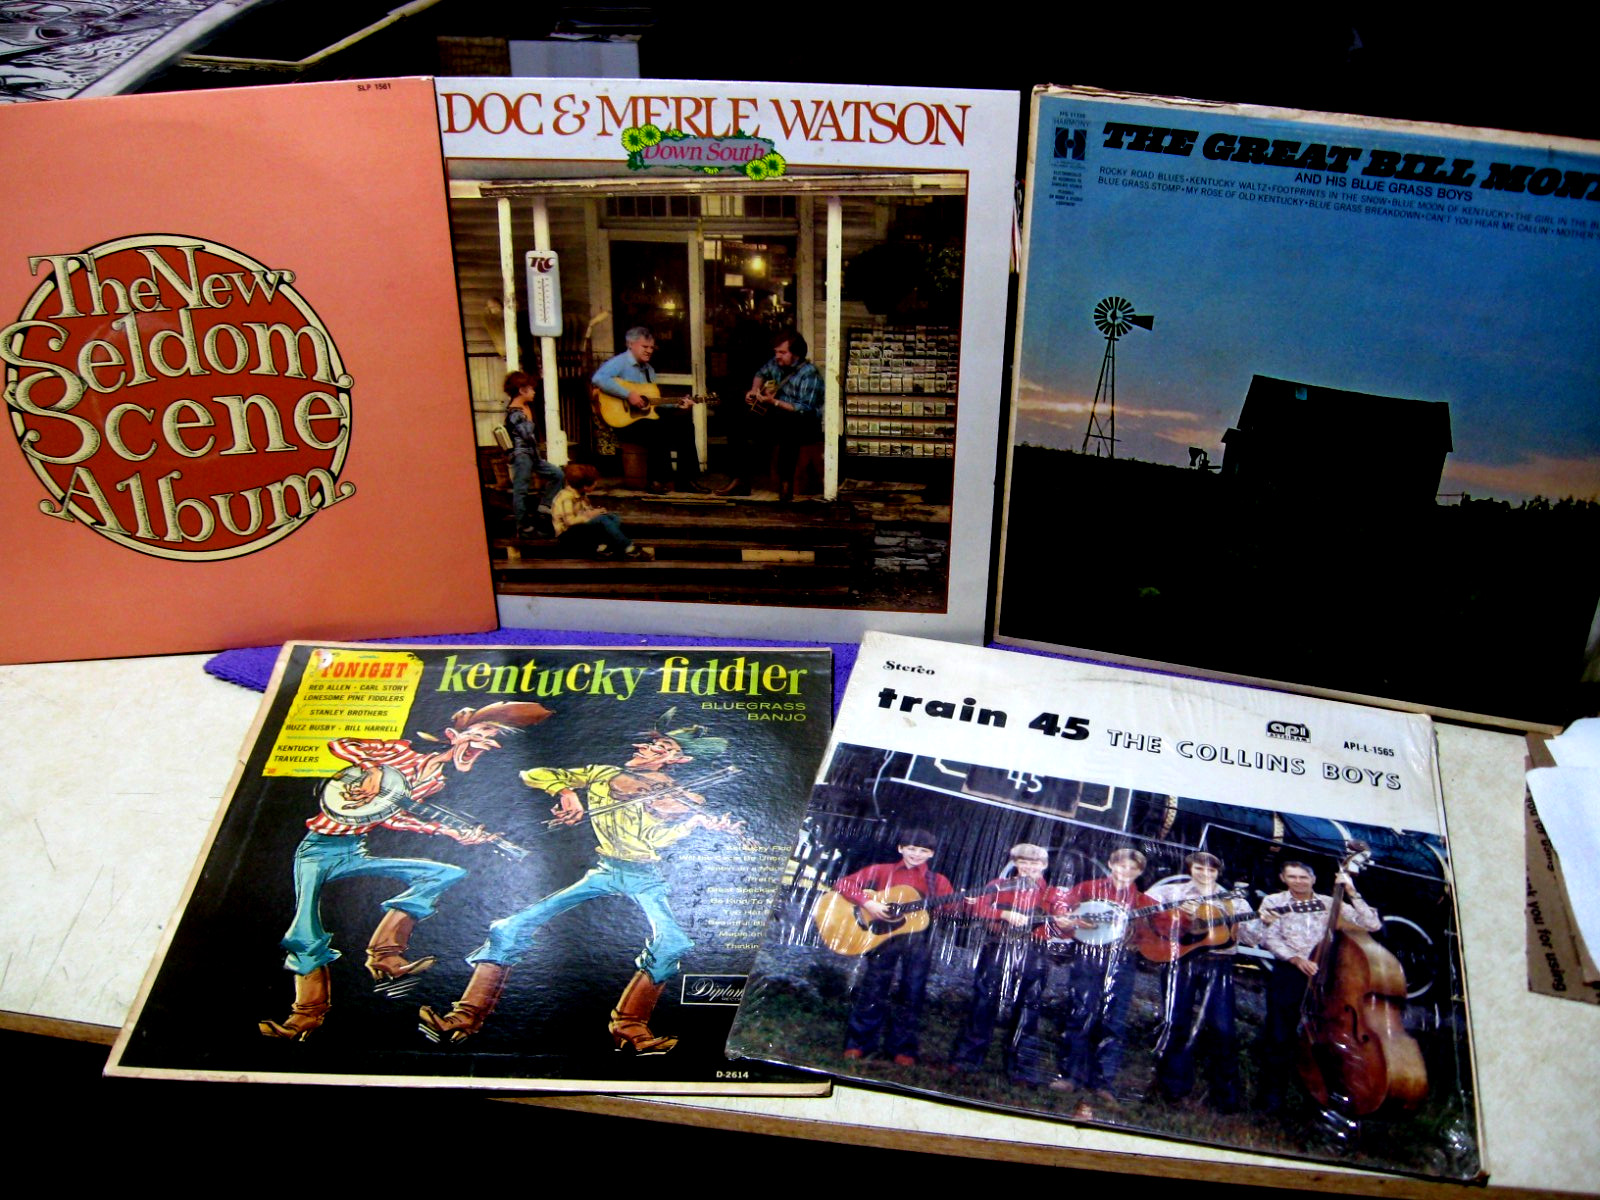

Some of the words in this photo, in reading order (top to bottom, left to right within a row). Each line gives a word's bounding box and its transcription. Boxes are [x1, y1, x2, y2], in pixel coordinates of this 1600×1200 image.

[357, 83, 371, 91] SLP
[440, 92, 544, 135] DOC
[552, 93, 590, 136] &
[596, 95, 760, 138] MERLE
[770, 98, 972, 147] WATSON
[643, 142, 703, 160] Down
[706, 142, 766, 162] South
[1103, 121, 1199, 157] THE
[1202, 132, 1363, 174] GREAT
[1361, 149, 1477, 187] BILL
[1097, 175, 1121, 186] BLUE
[1121, 177, 1150, 190] GRASS
[1152, 181, 1181, 192] STOMP
[1185, 185, 1198, 195] MY
[1201, 187, 1222, 198] ROSE
[1224, 189, 1236, 199] OF
[1238, 191, 1256, 201] OLD
[1258, 193, 1305, 207] KENTUCKY
[1308, 200, 1331, 211] BLUE
[1333, 202, 1362, 214] GRASS
[1099, 166, 1128, 176] ROCKY
[1131, 169, 1154, 180] ROAD
[1157, 172, 1184, 183] BLUES
[1187, 175, 1235, 188] KENTUCKY
[1239, 181, 1268, 192] WALTZ
[1272, 184, 1326, 199] FOOTPRINTS
[1328, 190, 1338, 200] IN
[1341, 192, 1358, 202] THE
[1361, 194, 1386, 205] SNOW
[1294, 172, 1322, 185] AND
[1325, 175, 1347, 188] HIS
[1351, 178, 1385, 192] BLUE
[1388, 182, 1433, 197] GRASS
[1437, 188, 1473, 202] BOYS
[28, 252, 162, 319] The
[136, 244, 296, 313] New
[0, 308, 355, 411] Seldom
[15, 371, 348, 466] Scene
[39, 466, 356, 543] Album
[320, 661, 409, 679] TONIGHT
[435, 654, 648, 701] kentucky
[656, 655, 808, 697] fiddler
[882, 659, 936, 676] Stereo
[303, 694, 345, 702] LONESOME
[347, 694, 366, 702] PINE
[367, 694, 405, 702] FIDDLERS
[347, 709, 389, 717] BROTHERS
[701, 702, 807, 711] BLUEGRASS
[285, 724, 307, 732] BUZZ
[308, 724, 337, 732] BUSBY
[364, 725, 400, 733] HARRELL
[747, 712, 807, 722] BANJO
[878, 687, 1008, 729] train
[1028, 711, 1090, 741] 45
[273, 755, 320, 763] TRAVELERS
[276, 744, 321, 752] KENTUCKY
[1107, 728, 1162, 754] THE
[1176, 739, 1306, 776] COLLINS
[1322, 762, 1402, 791] BOYS
[1527, 901, 1545, 925] you
[1537, 928, 1553, 950] for
[716, 1070, 749, 1079] D-2614
